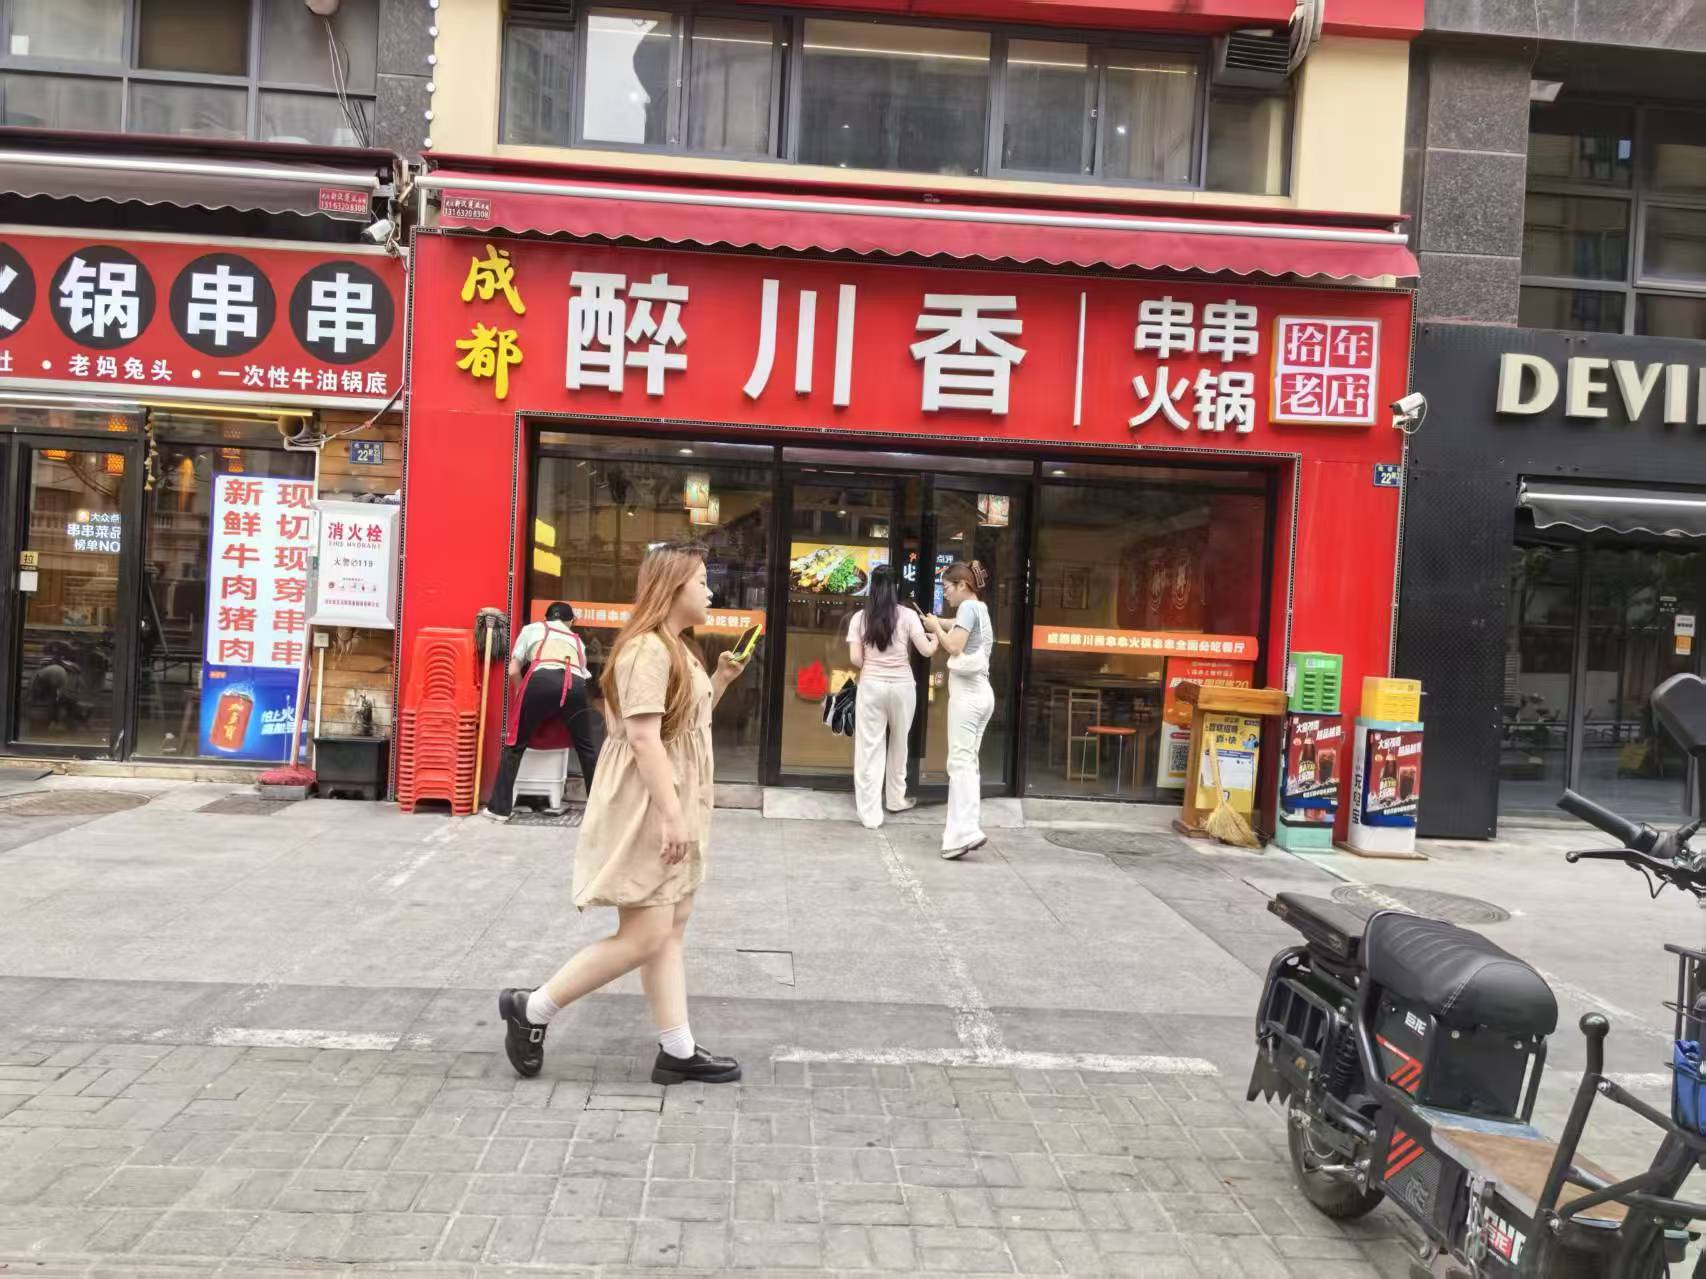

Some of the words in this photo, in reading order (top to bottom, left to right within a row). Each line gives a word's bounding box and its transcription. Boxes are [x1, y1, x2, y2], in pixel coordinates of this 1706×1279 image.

[456, 243, 526, 399] 成都
[565, 271, 1027, 415] 醉川香
[1134, 296, 1259, 362] 串串
[1286, 325, 1369, 365] 拾年
[68, 354, 173, 381] 老妈兔头
[218, 364, 388, 394] 一次性牛油锅底
[1128, 366, 1256, 433] 火锅
[1281, 374, 1367, 415] 老店
[328, 521, 383, 543] 消火栓
[218, 478, 265, 664] 新鲜牛肉猪肉
[271, 483, 314, 666] 现切现穿串串
